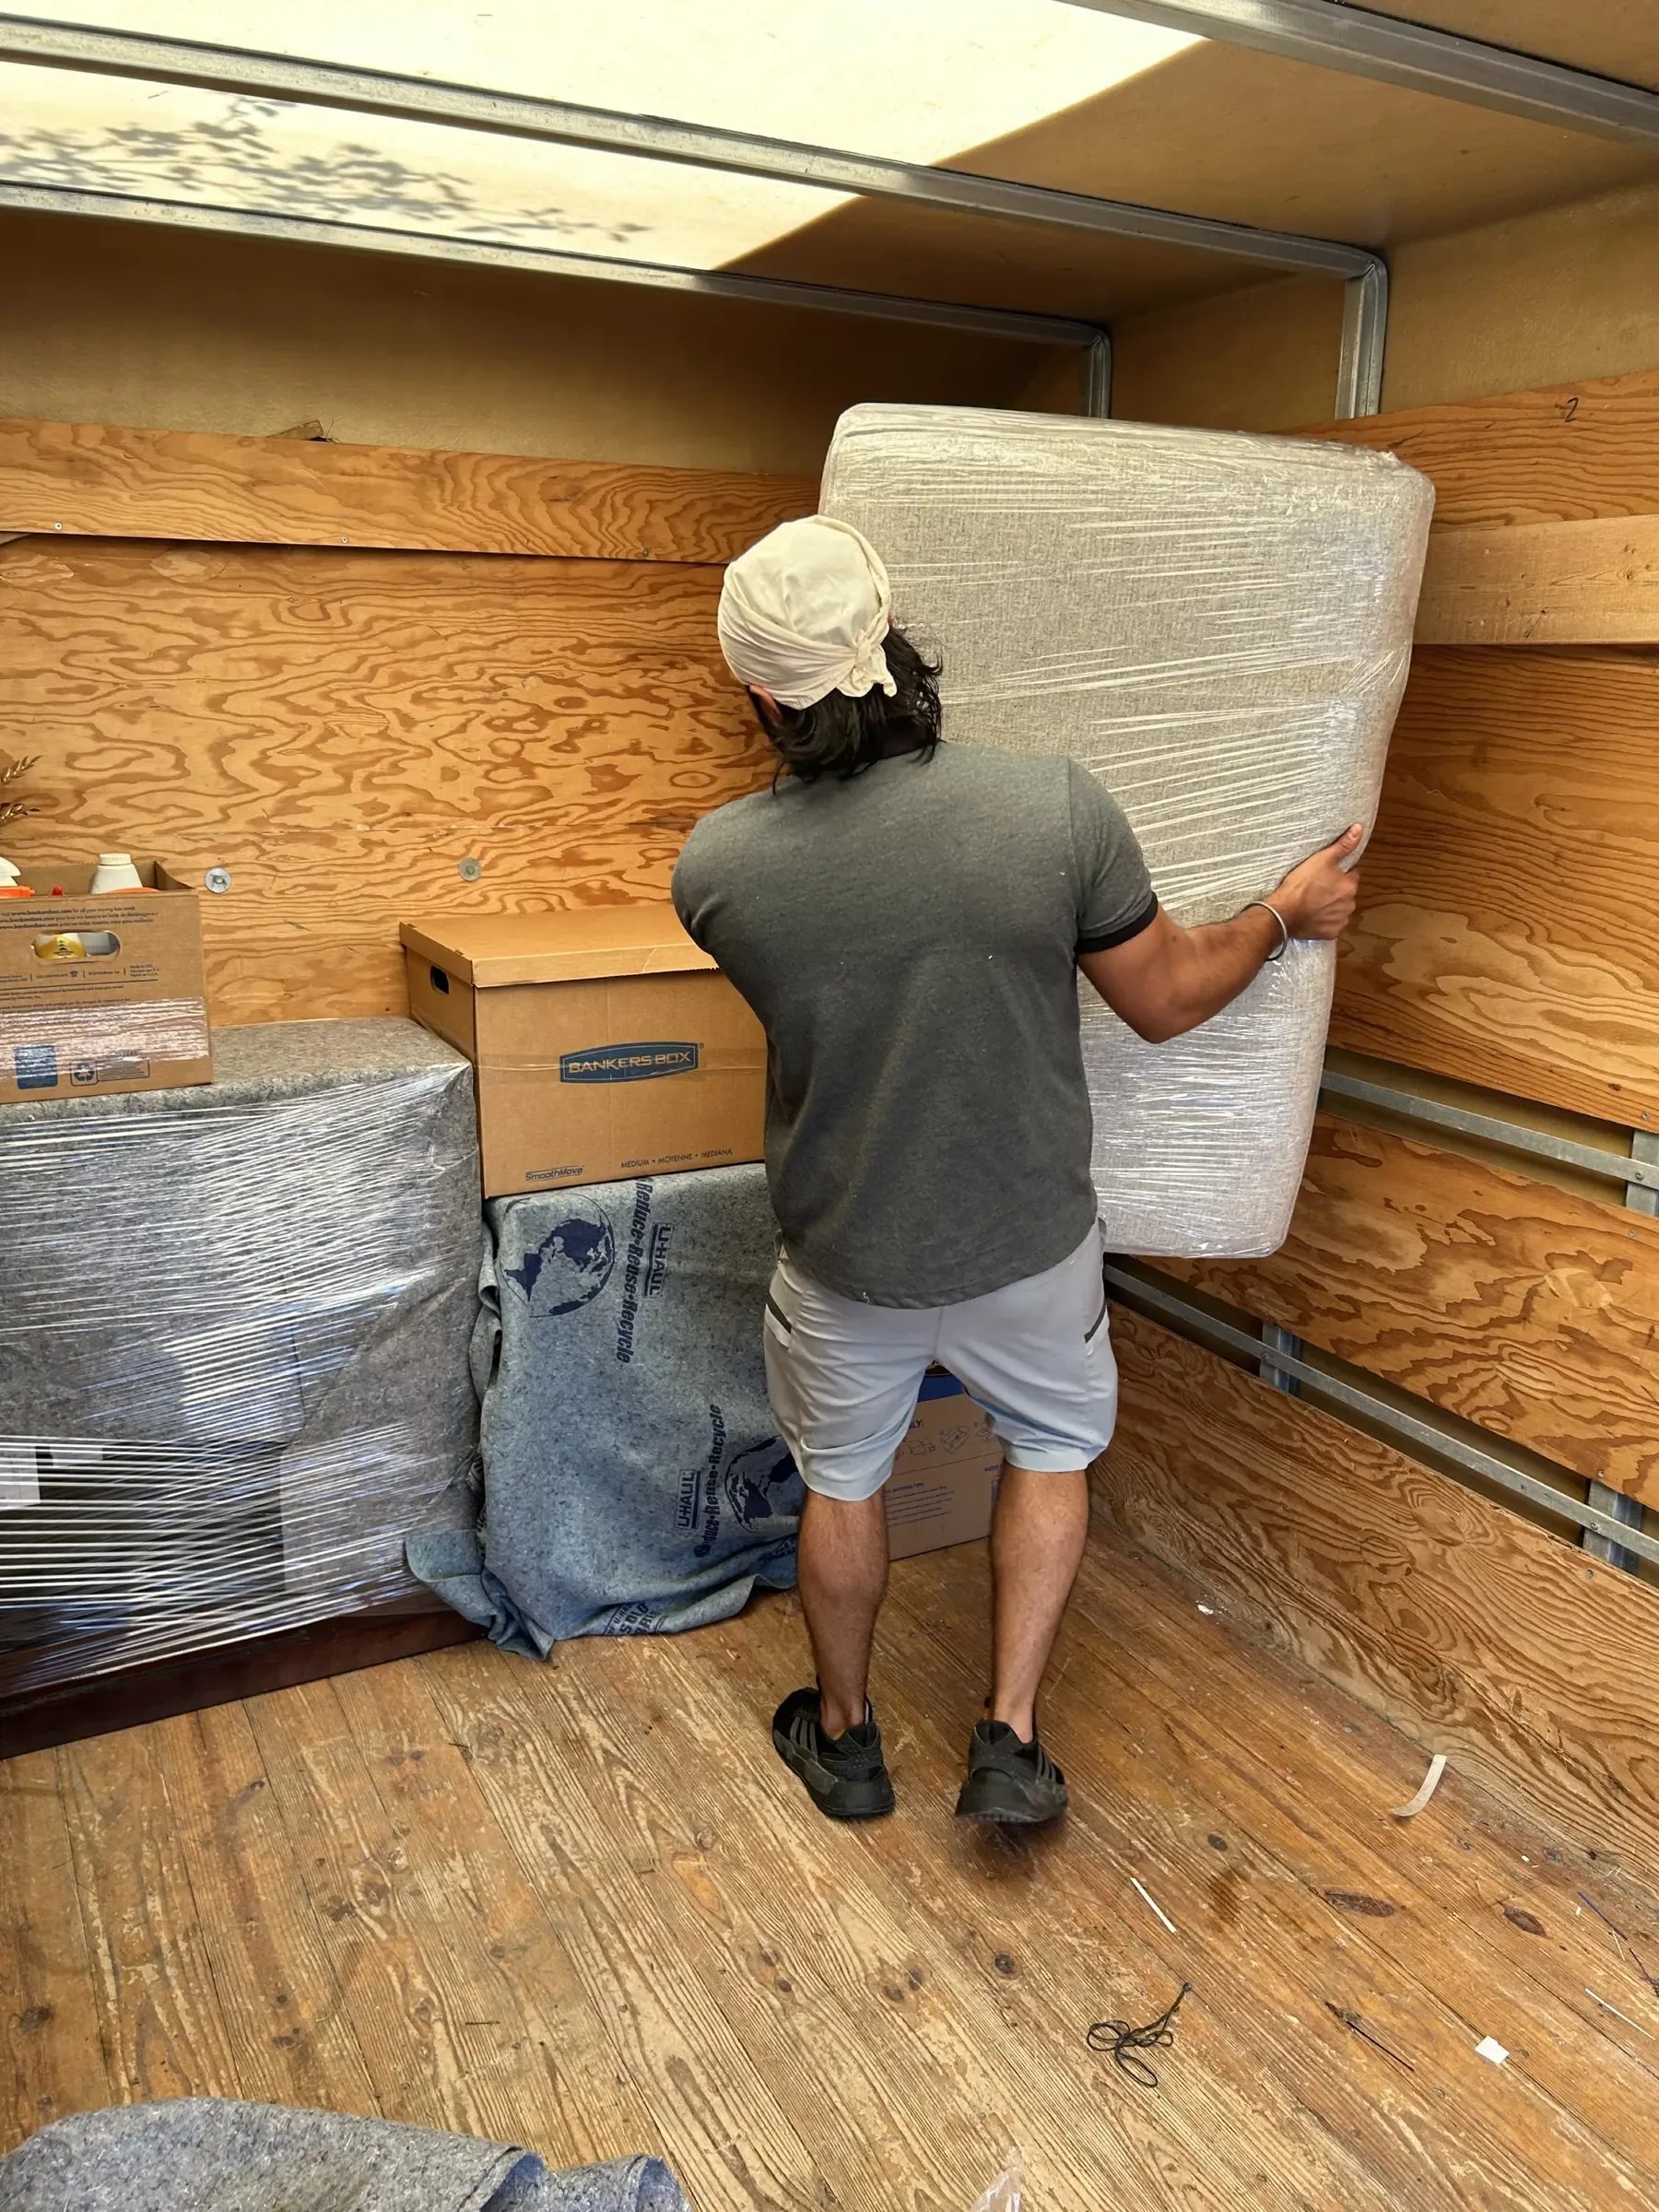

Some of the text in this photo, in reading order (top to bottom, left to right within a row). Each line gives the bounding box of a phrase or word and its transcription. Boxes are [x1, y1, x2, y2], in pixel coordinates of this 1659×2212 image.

[569, 1051, 691, 1074] BANKERS BOX
[525, 1166, 584, 1182] SmoothMove
[620, 1148, 733, 1170] MEDIUM MOYENNE MEDIANA
[616, 1182, 653, 1364] Reduce Reuse Recycle
[649, 1226, 672, 1296] U-HAUL
[708, 1404, 727, 1465] Recycle
[677, 1471, 696, 1528] U-HAUL
[703, 1469, 721, 1515] Reuse
